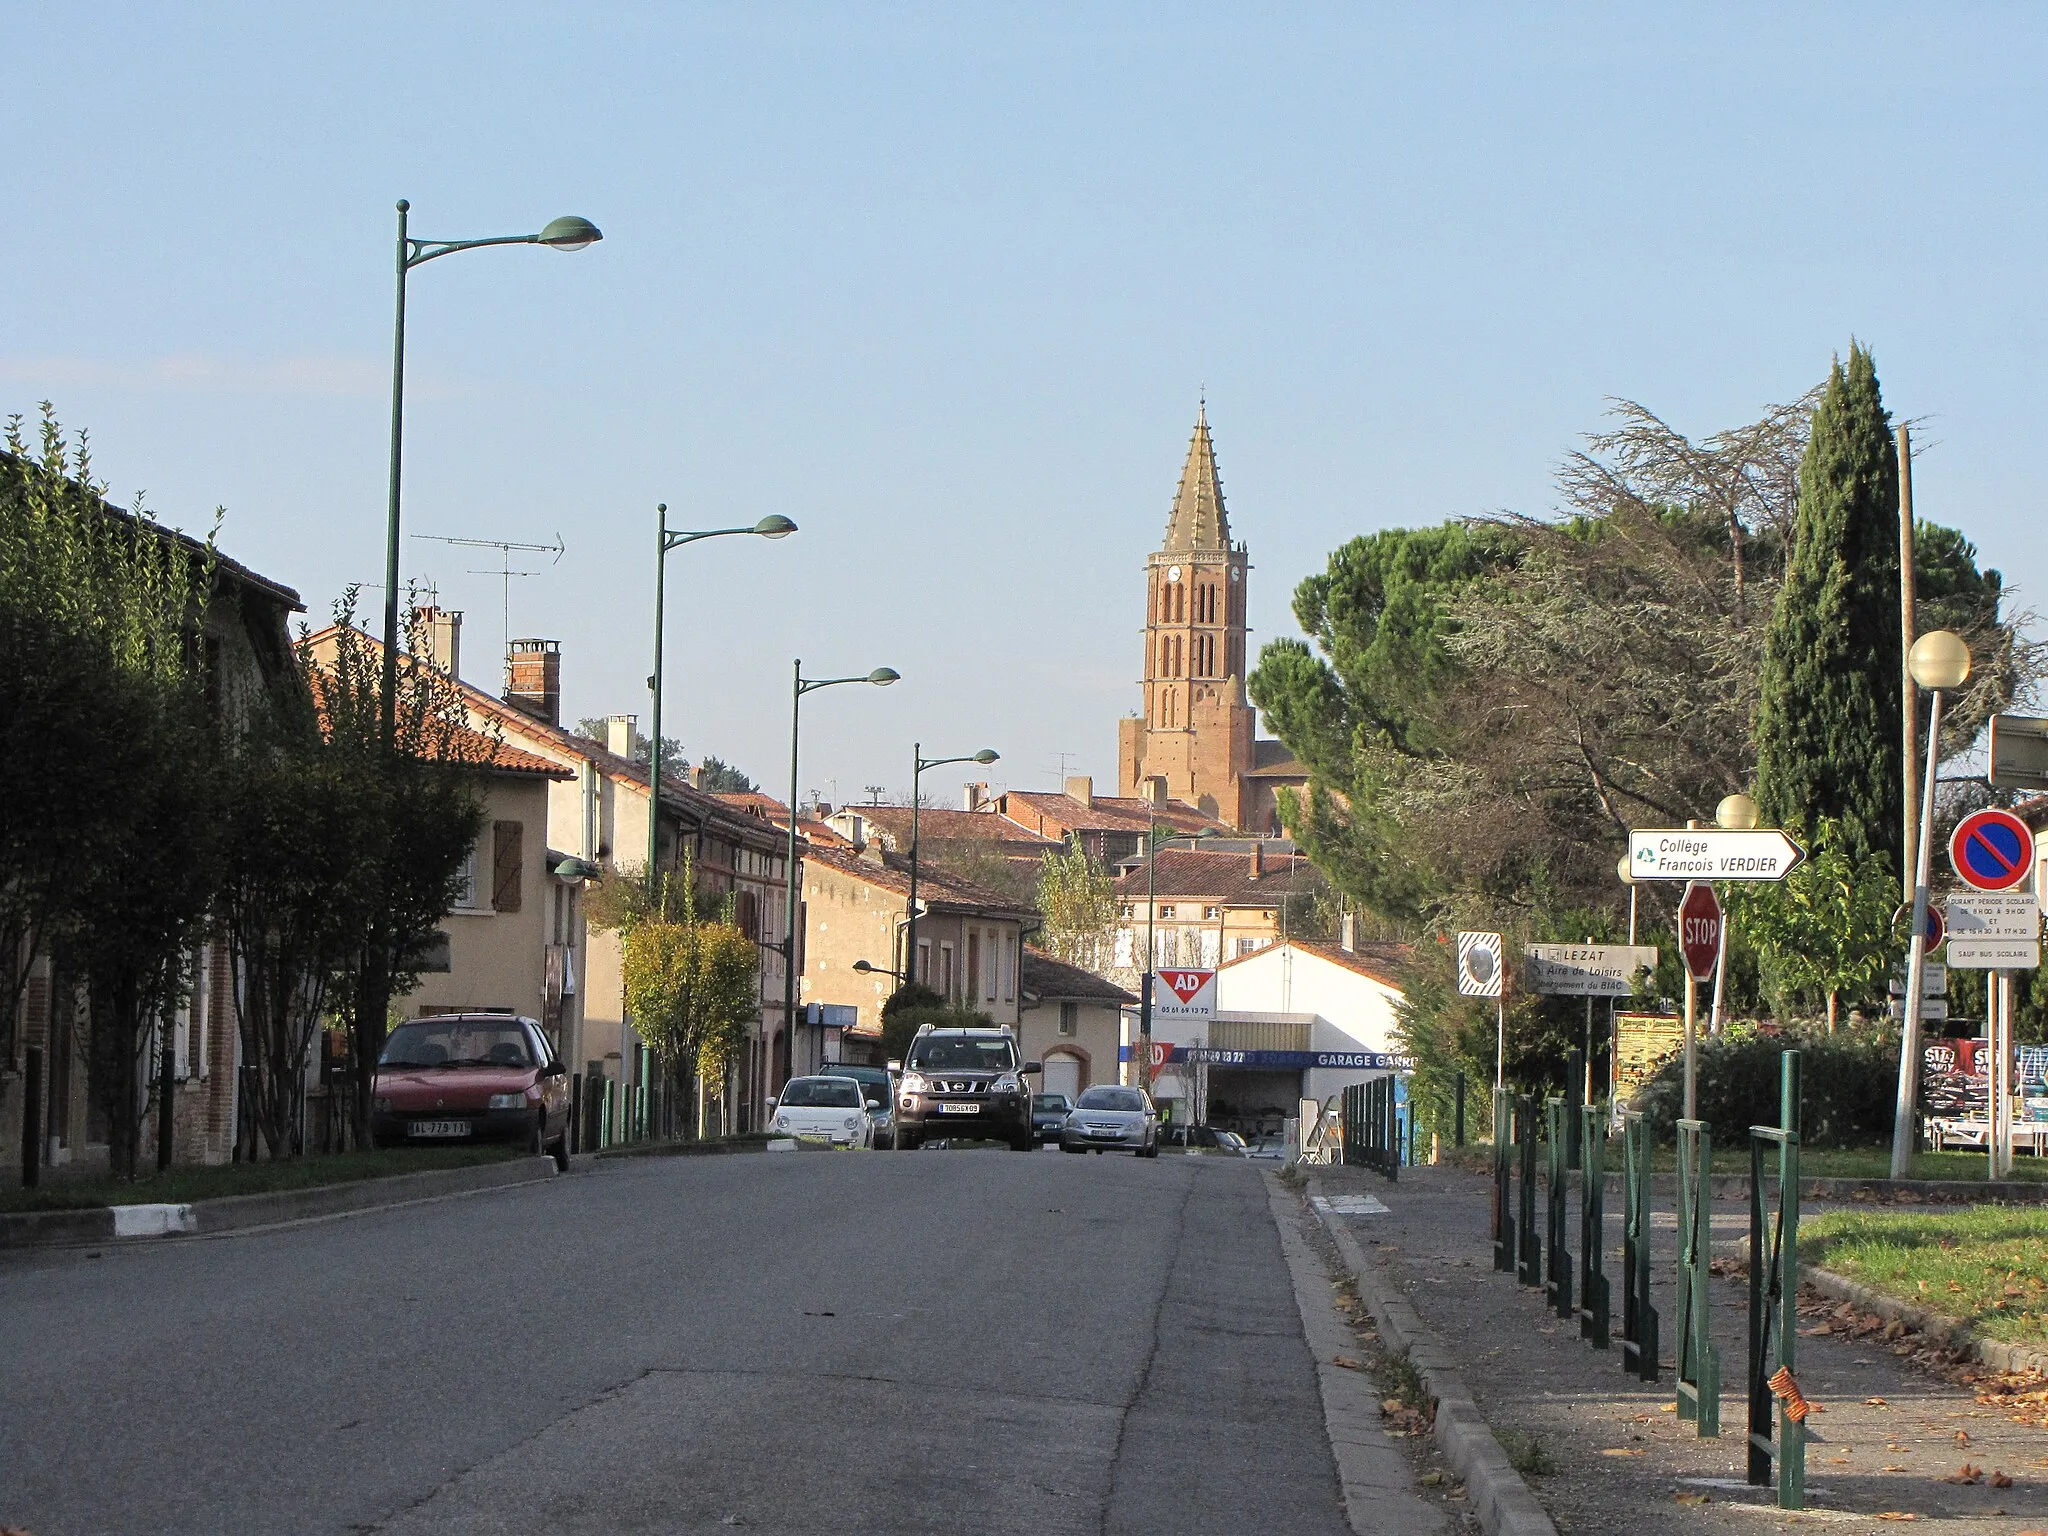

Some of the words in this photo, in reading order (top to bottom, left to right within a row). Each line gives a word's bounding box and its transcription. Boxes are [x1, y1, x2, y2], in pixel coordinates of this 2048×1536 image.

[1659, 838, 1708, 856] Collège
[1659, 857, 1713, 872] François
[1720, 857, 1777, 872] VERDIER
[1685, 917, 1717, 945] STOP
[1564, 950, 1605, 961] LEZAT
[1547, 965, 1568, 977] Aire
[1572, 966, 1585, 976] de
[1589, 966, 1622, 977] Loisirs
[1174, 973, 1200, 991] AD
[1587, 981, 1598, 990] du
[1161, 1006, 1170, 1014] 05
[1200, 1007, 1209, 1015] 72
[1318, 1054, 1371, 1067] GARAGE
